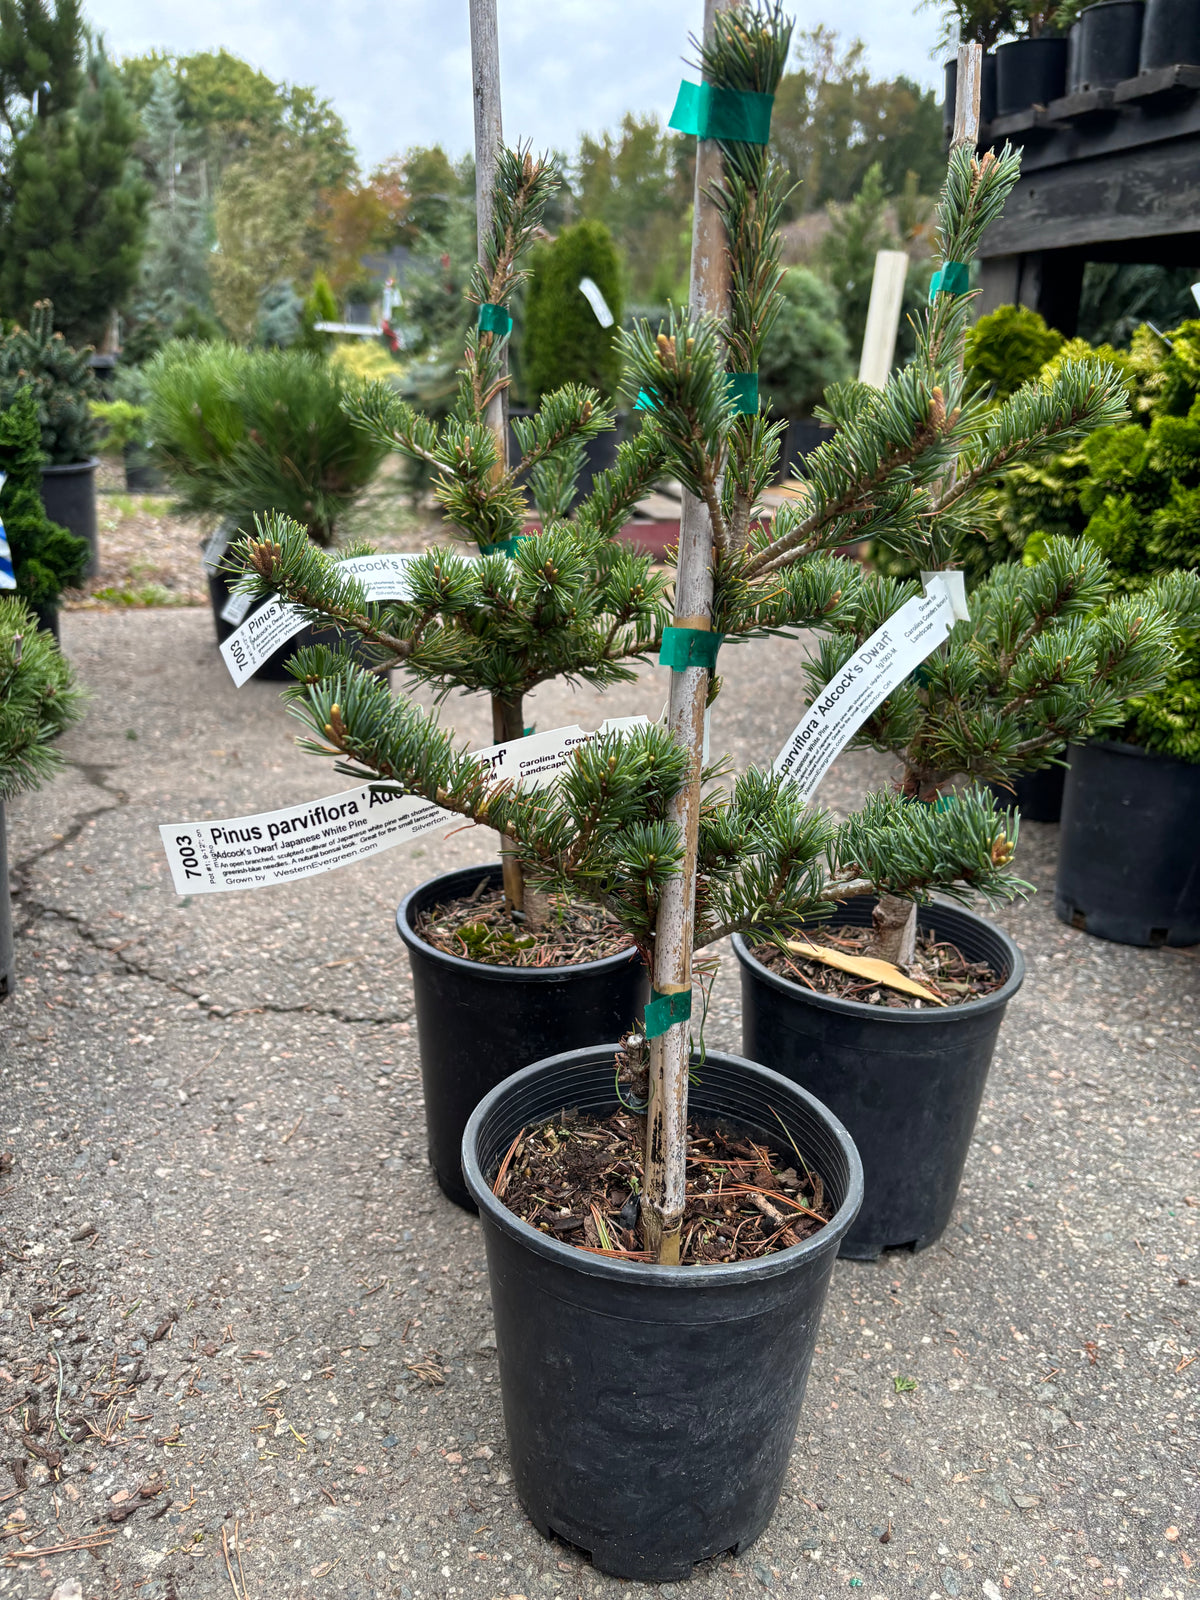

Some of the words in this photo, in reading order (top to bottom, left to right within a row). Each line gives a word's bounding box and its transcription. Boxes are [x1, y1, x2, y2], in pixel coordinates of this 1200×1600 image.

[248, 606, 277, 635] Pinus
[230, 639, 249, 672] 7003
[781, 719, 819, 775] parviflora
[813, 665, 863, 717] 'Adcock's
[859, 630, 893, 665] Dwarf'
[564, 735, 595, 746] Grown
[806, 737, 821, 752] White
[818, 724, 830, 737] Pine
[519, 753, 556, 769] Carolina
[520, 760, 566, 778] Landscape
[210, 826, 262, 845] Pinus
[267, 801, 359, 842] parviflora
[217, 847, 252, 859] Adcock's
[253, 841, 278, 854] Dwarf
[280, 833, 321, 849] Japanese
[322, 825, 348, 838] White
[348, 818, 368, 829] Pine
[277, 848, 304, 860] sculpted
[305, 842, 327, 853] cultivar
[336, 830, 367, 843] Japanese
[367, 823, 384, 832] white
[384, 818, 398, 827] pine
[398, 814, 410, 822] with
[320, 845, 342, 857] bonsai
[359, 832, 377, 843] Great
[378, 829, 387, 837] for
[387, 825, 397, 833] the
[398, 820, 413, 829] small
[413, 810, 440, 823] lanscape
[176, 835, 202, 879] 7003
[225, 876, 253, 885] Grown
[273, 842, 378, 878] WesternEvergreen.com
